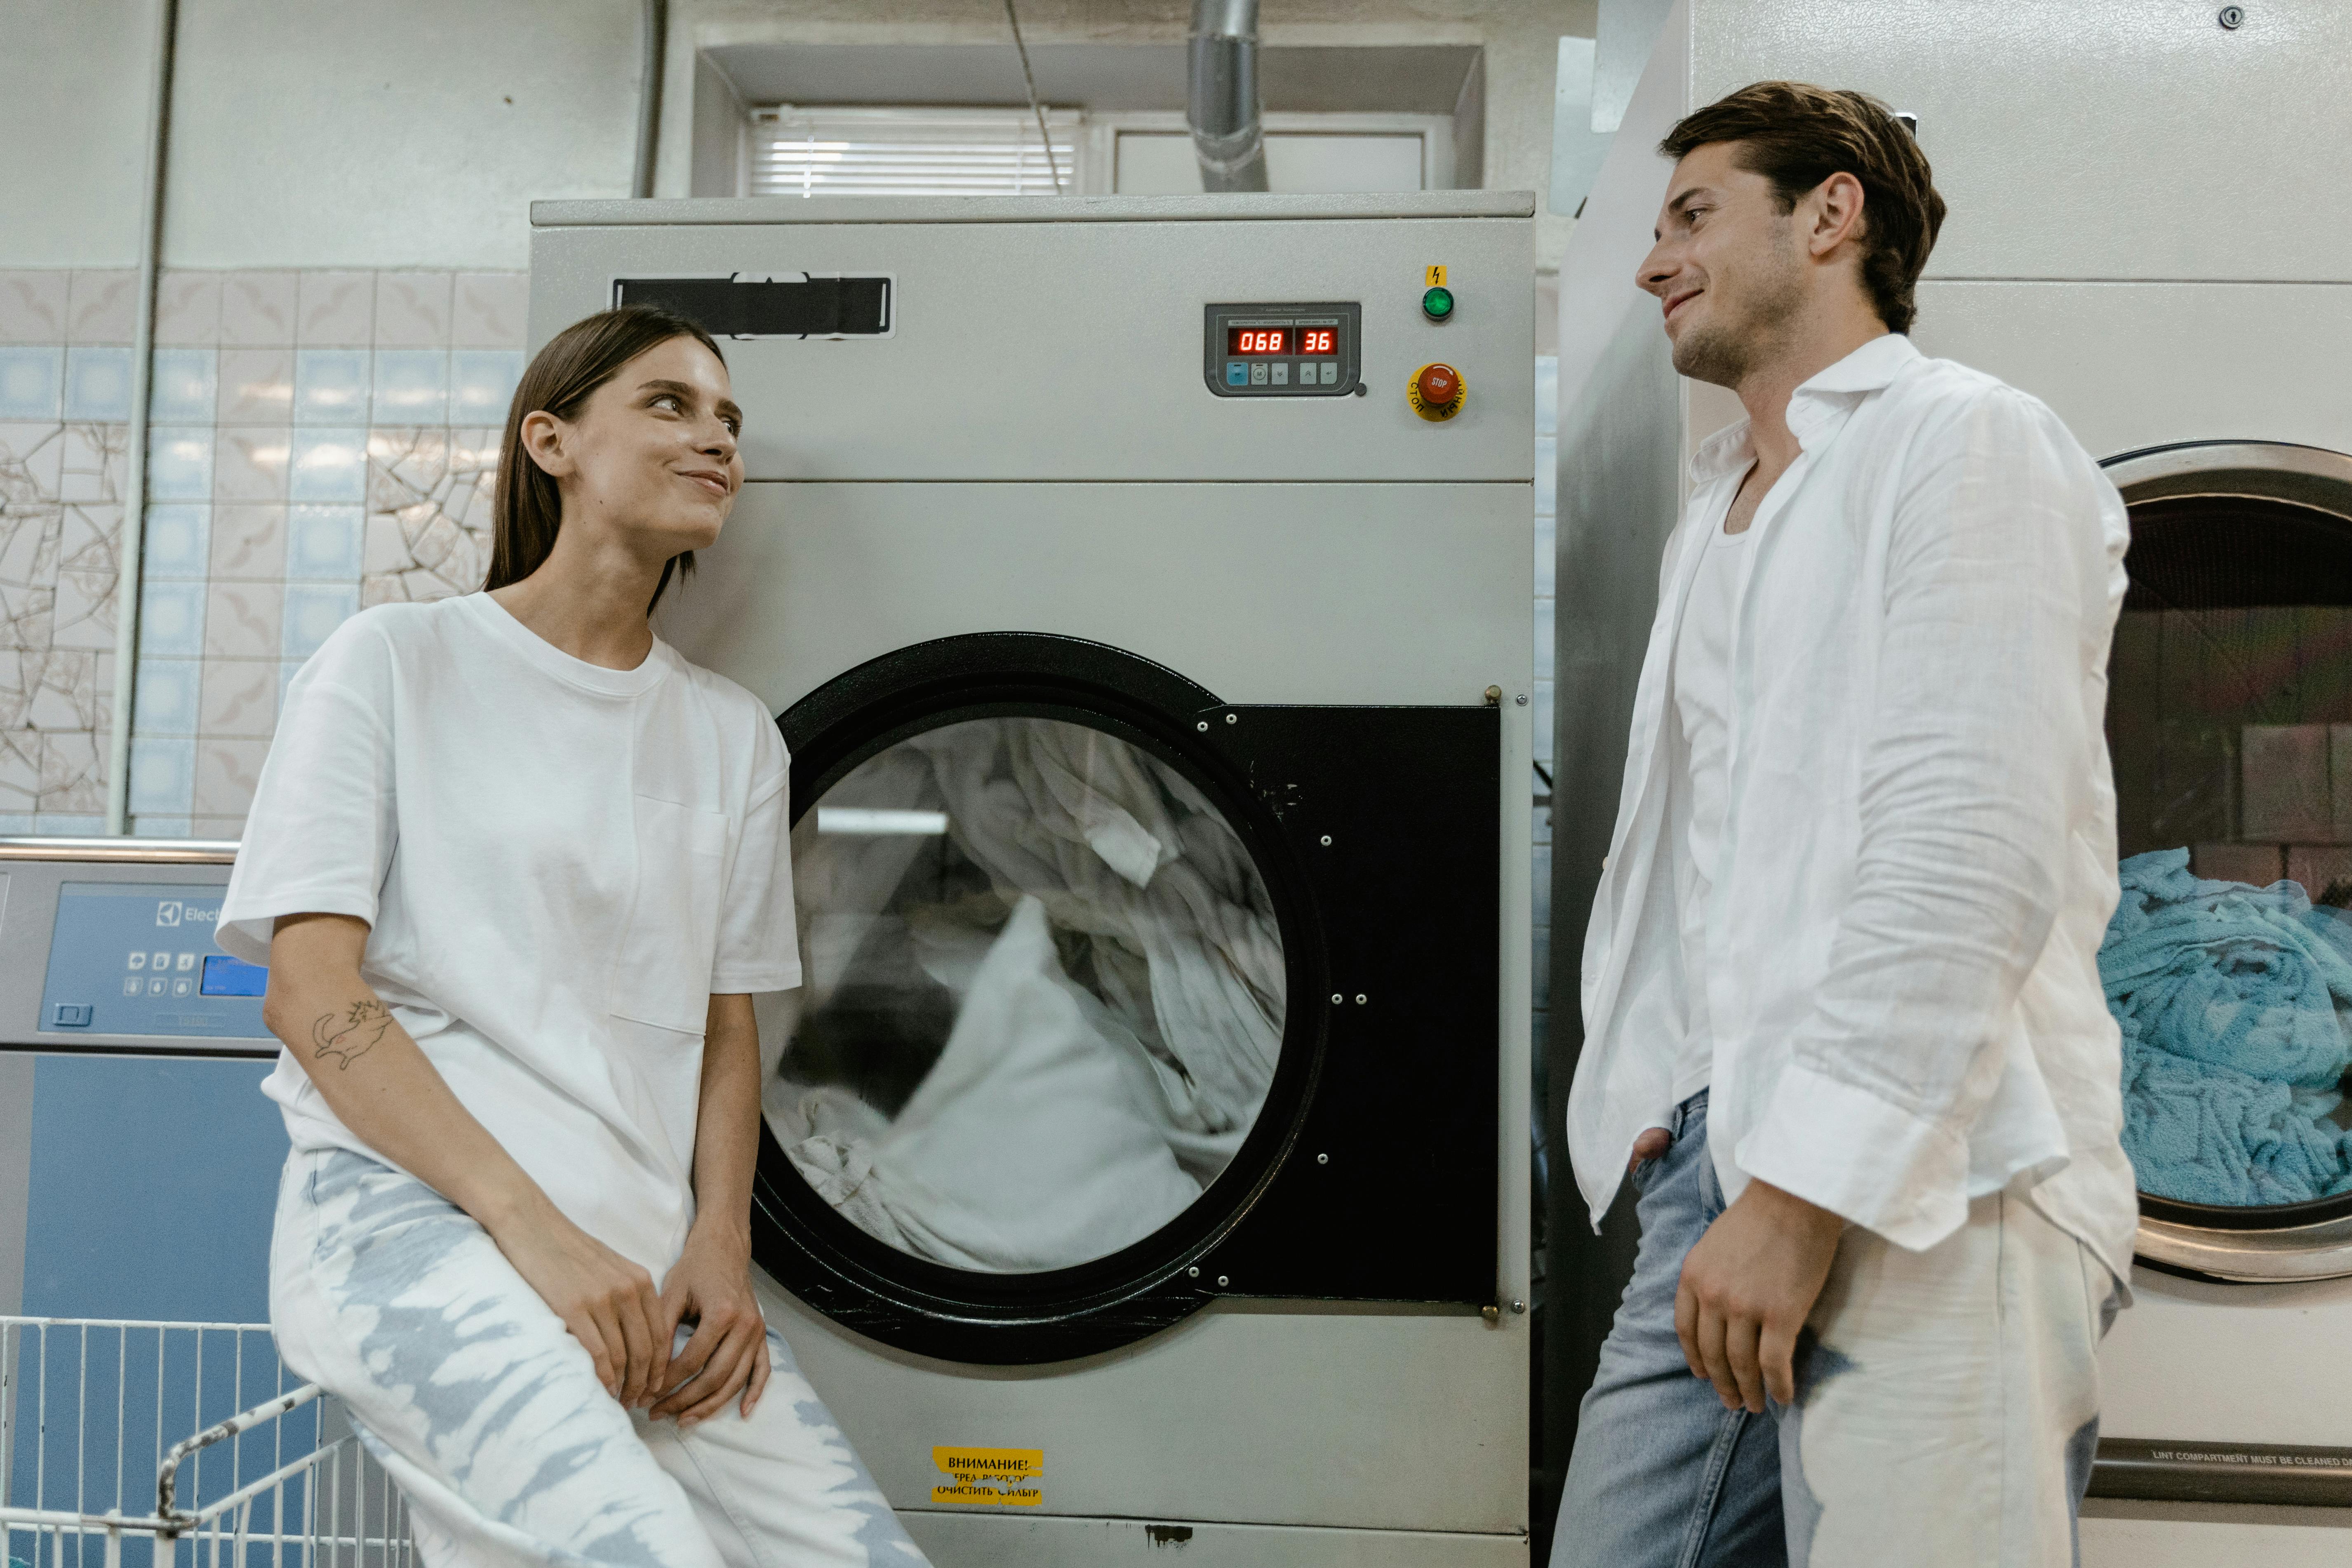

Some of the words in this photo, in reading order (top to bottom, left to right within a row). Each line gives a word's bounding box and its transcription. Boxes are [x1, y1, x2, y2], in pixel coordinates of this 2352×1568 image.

[1240, 333, 1282, 350] 068
[1306, 333, 1329, 350] 36
[1432, 377, 1447, 388] STOP
[2152, 1451, 2173, 1460] LINT
[2176, 1452, 2248, 1462] COMPARTMENT
[2250, 1455, 2276, 1464] MUST
[949, 1458, 1028, 1471] ВНИМАНИЕ!
[955, 1473, 976, 1482] ЕРЕД
[937, 1486, 993, 1495] ОЧИСТИТЬ
